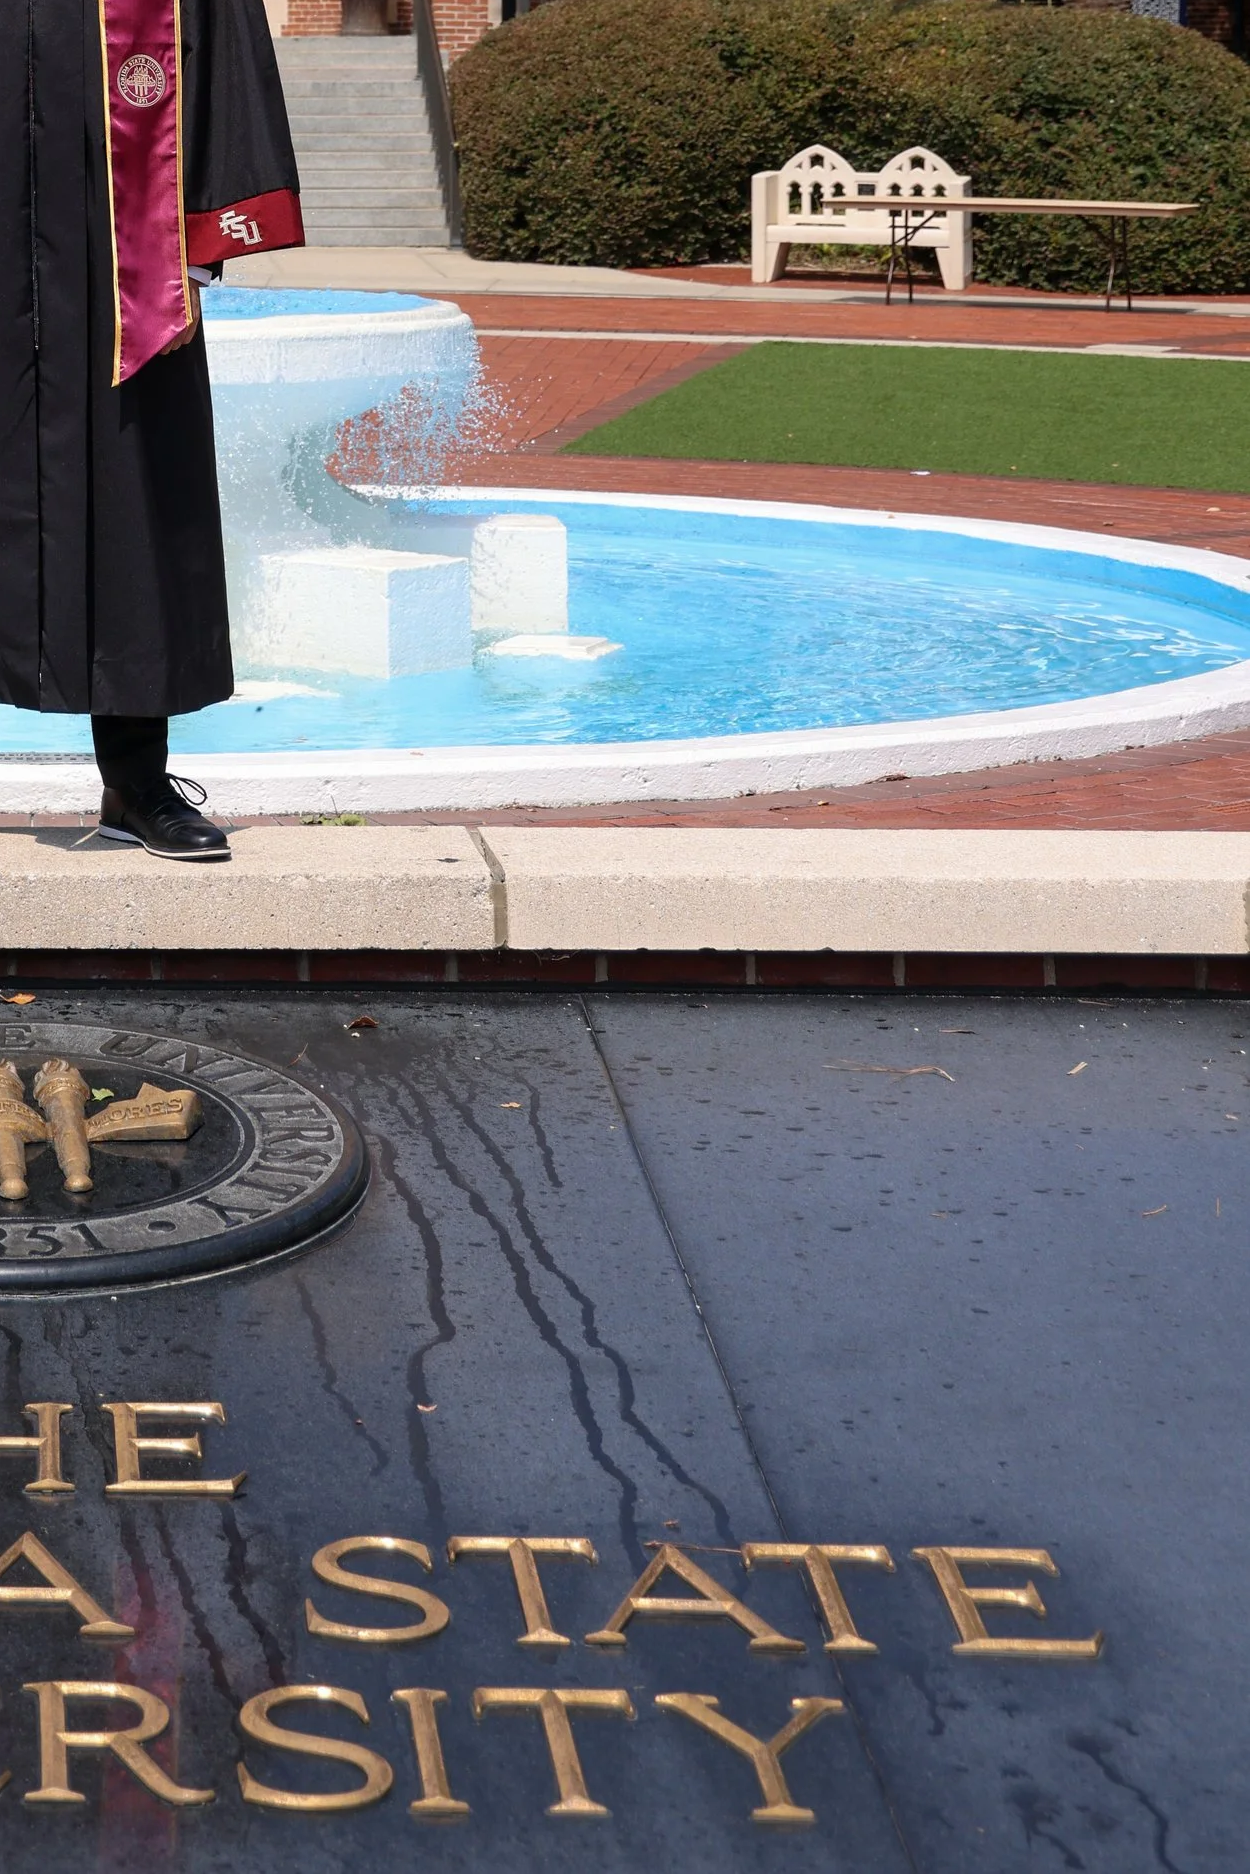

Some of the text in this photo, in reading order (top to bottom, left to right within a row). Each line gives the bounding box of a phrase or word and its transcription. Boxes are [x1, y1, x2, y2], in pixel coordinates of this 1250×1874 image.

[128, 57, 146, 66] STATE
[219, 210, 262, 246] FSU
[100, 1031, 336, 1228] UNIVERSITY
[306, 1536, 1105, 1658] STATE
